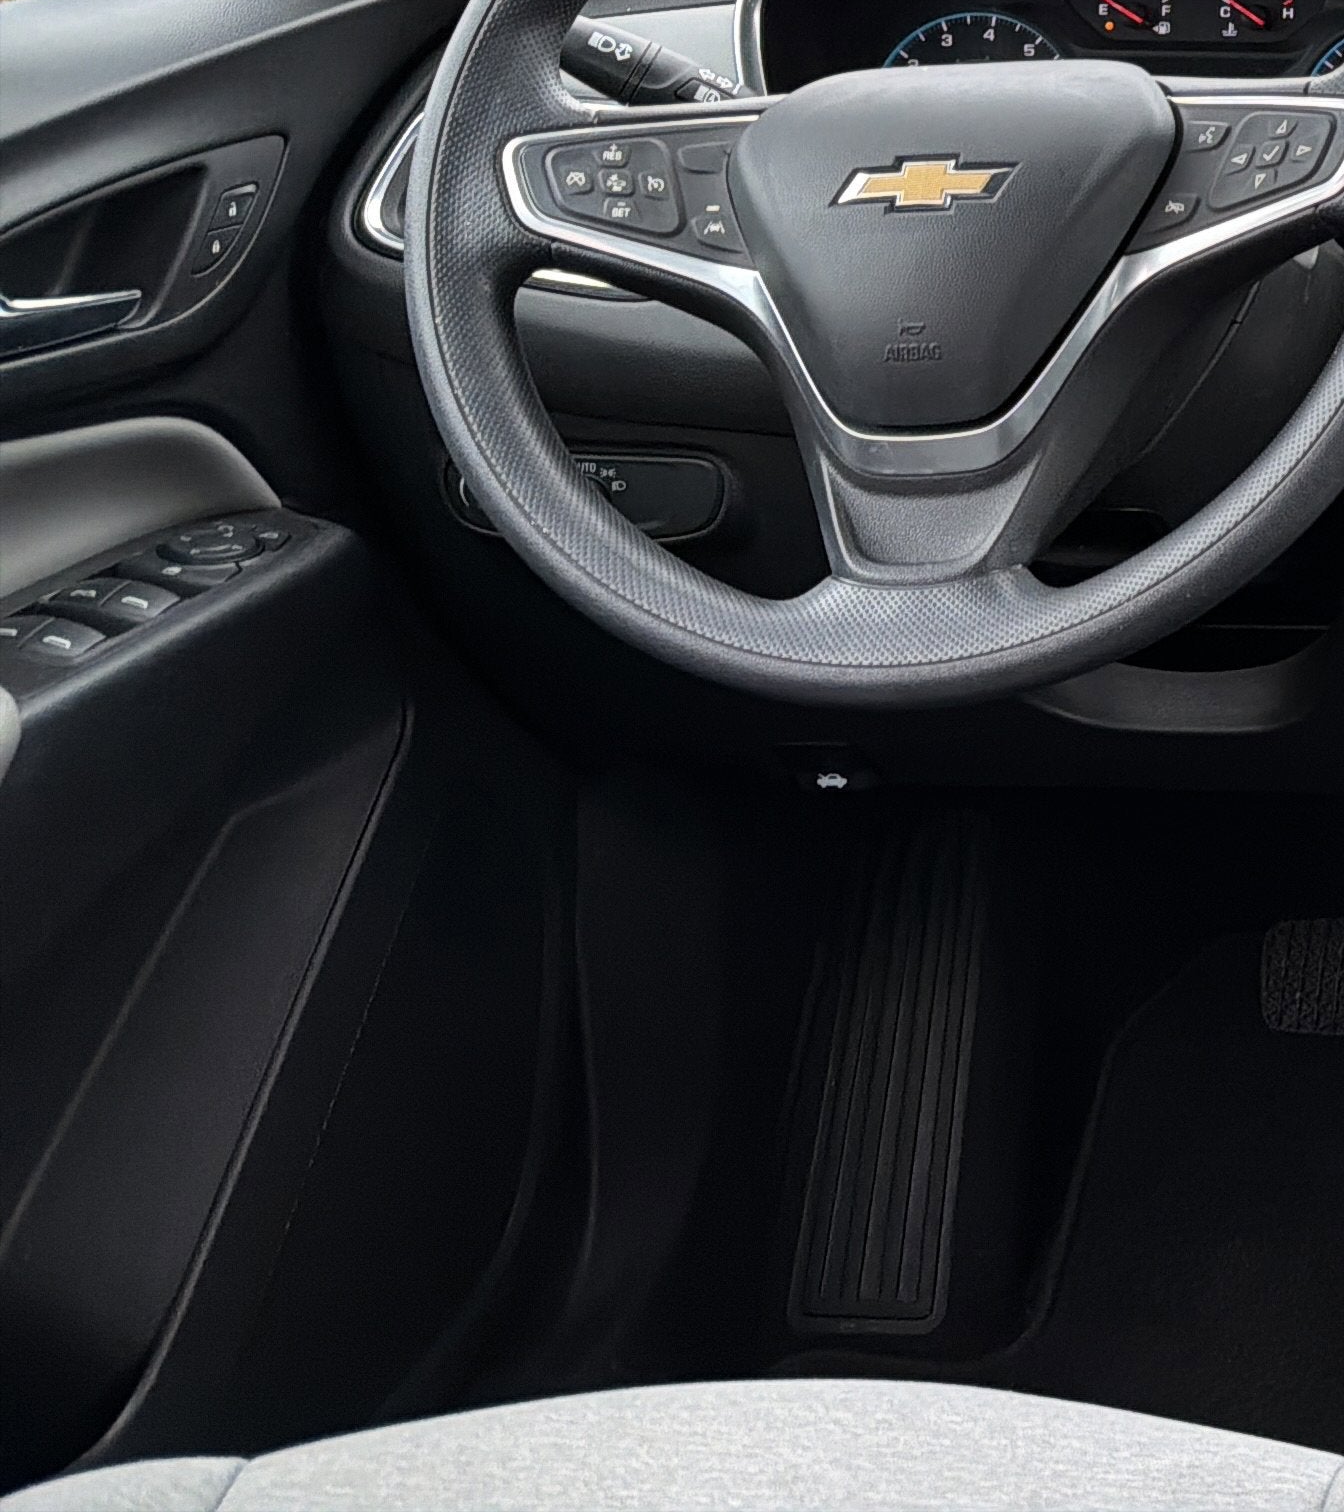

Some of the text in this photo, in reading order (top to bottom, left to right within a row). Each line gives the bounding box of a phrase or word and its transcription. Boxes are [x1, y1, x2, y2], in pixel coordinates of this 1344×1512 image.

[1098, 4, 1109, 17] E
[1161, 5, 1171, 17] F
[1220, 6, 1231, 18] C
[1282, 7, 1294, 19] H
[941, 34, 952, 47] 3
[983, 28, 995, 42] 4
[1023, 43, 1035, 57] 5
[883, 342, 942, 363] AIRBAG
